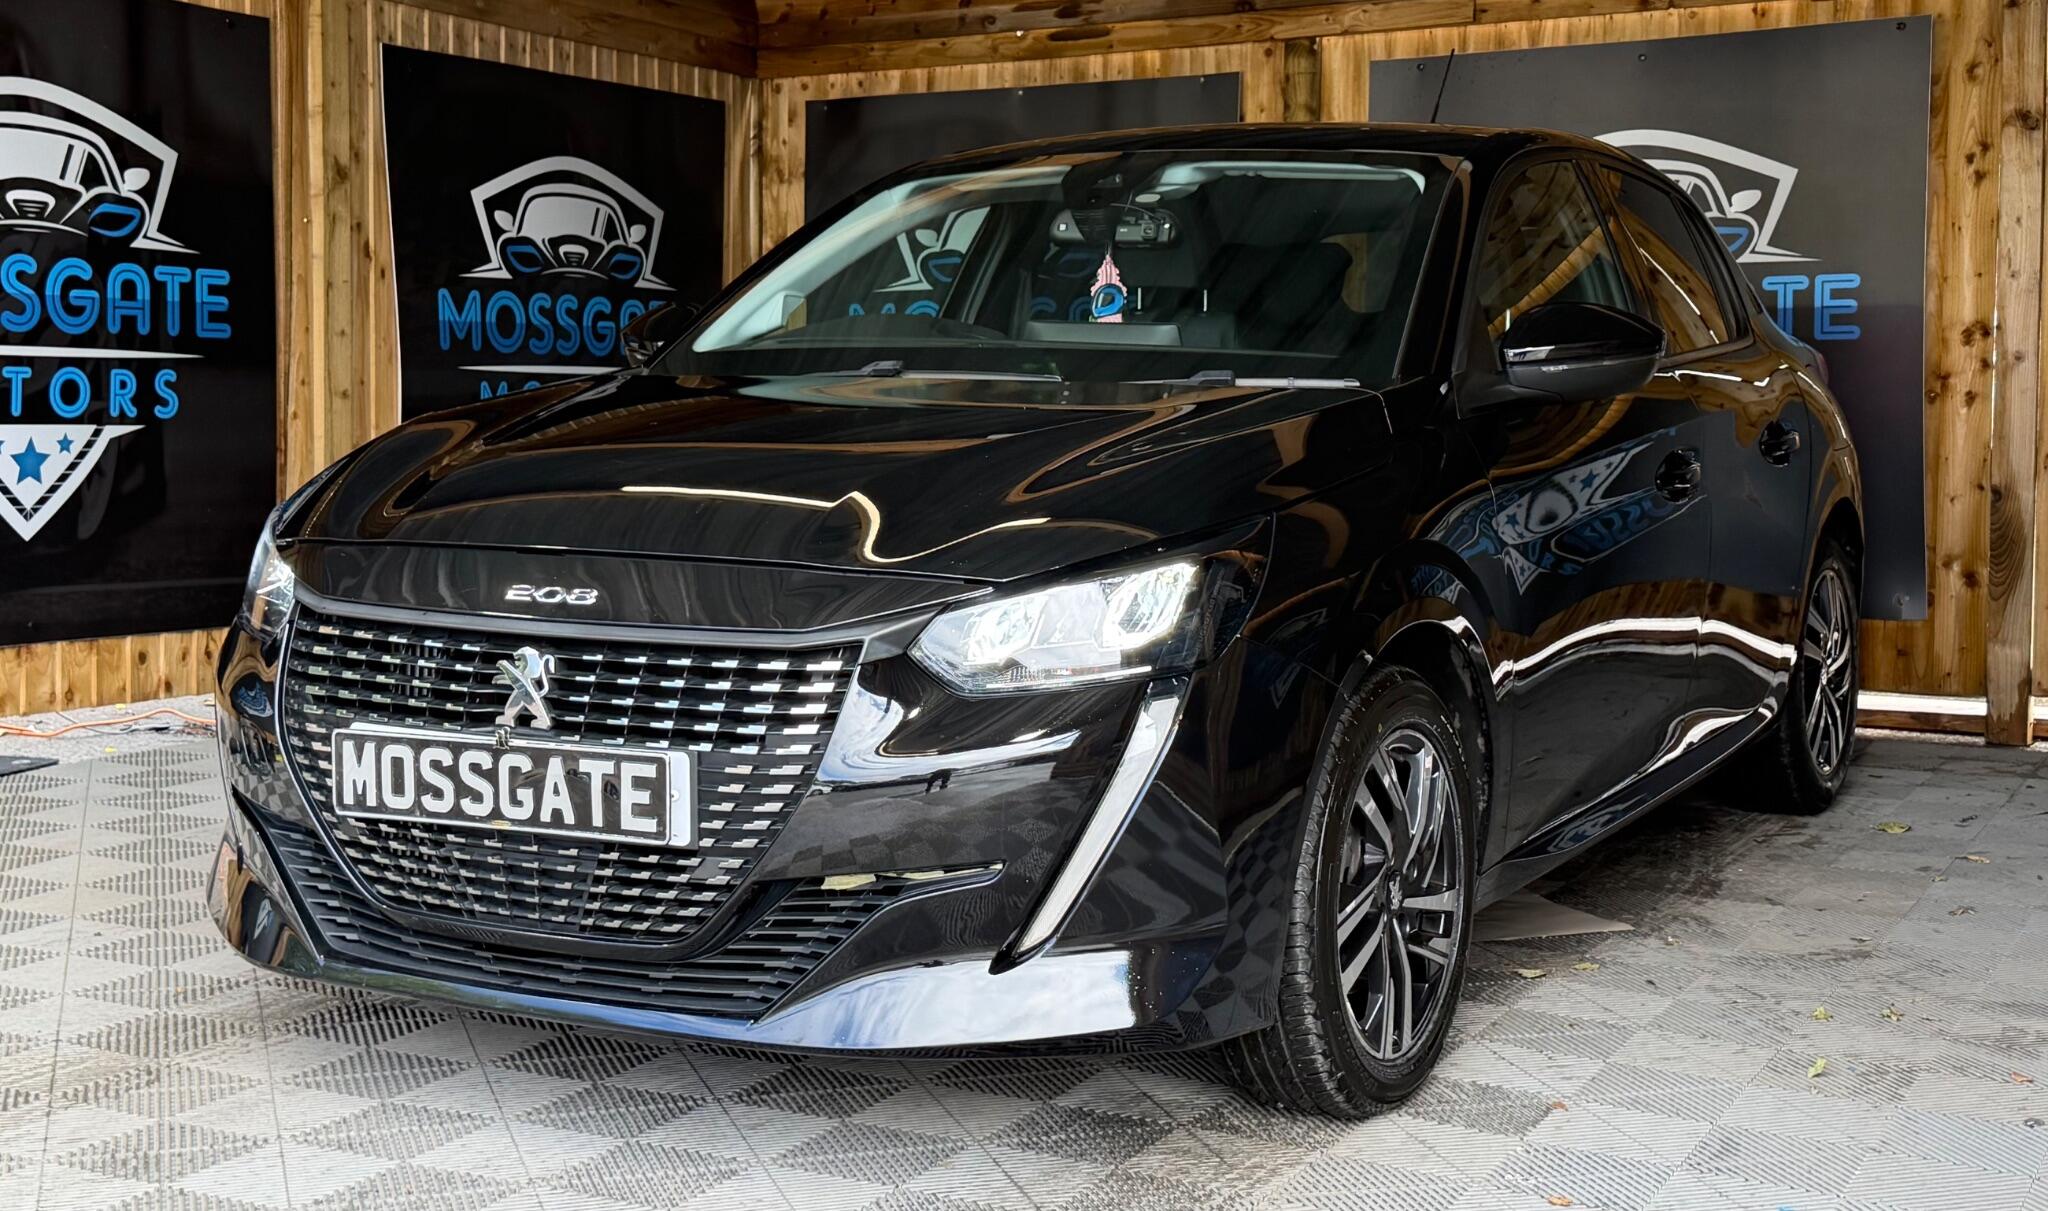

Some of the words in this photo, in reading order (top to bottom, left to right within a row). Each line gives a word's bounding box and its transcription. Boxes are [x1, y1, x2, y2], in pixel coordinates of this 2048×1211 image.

[437, 287, 667, 357] MOSSG
[504, 584, 599, 605] 208
[342, 739, 658, 833] MOSSGATE
